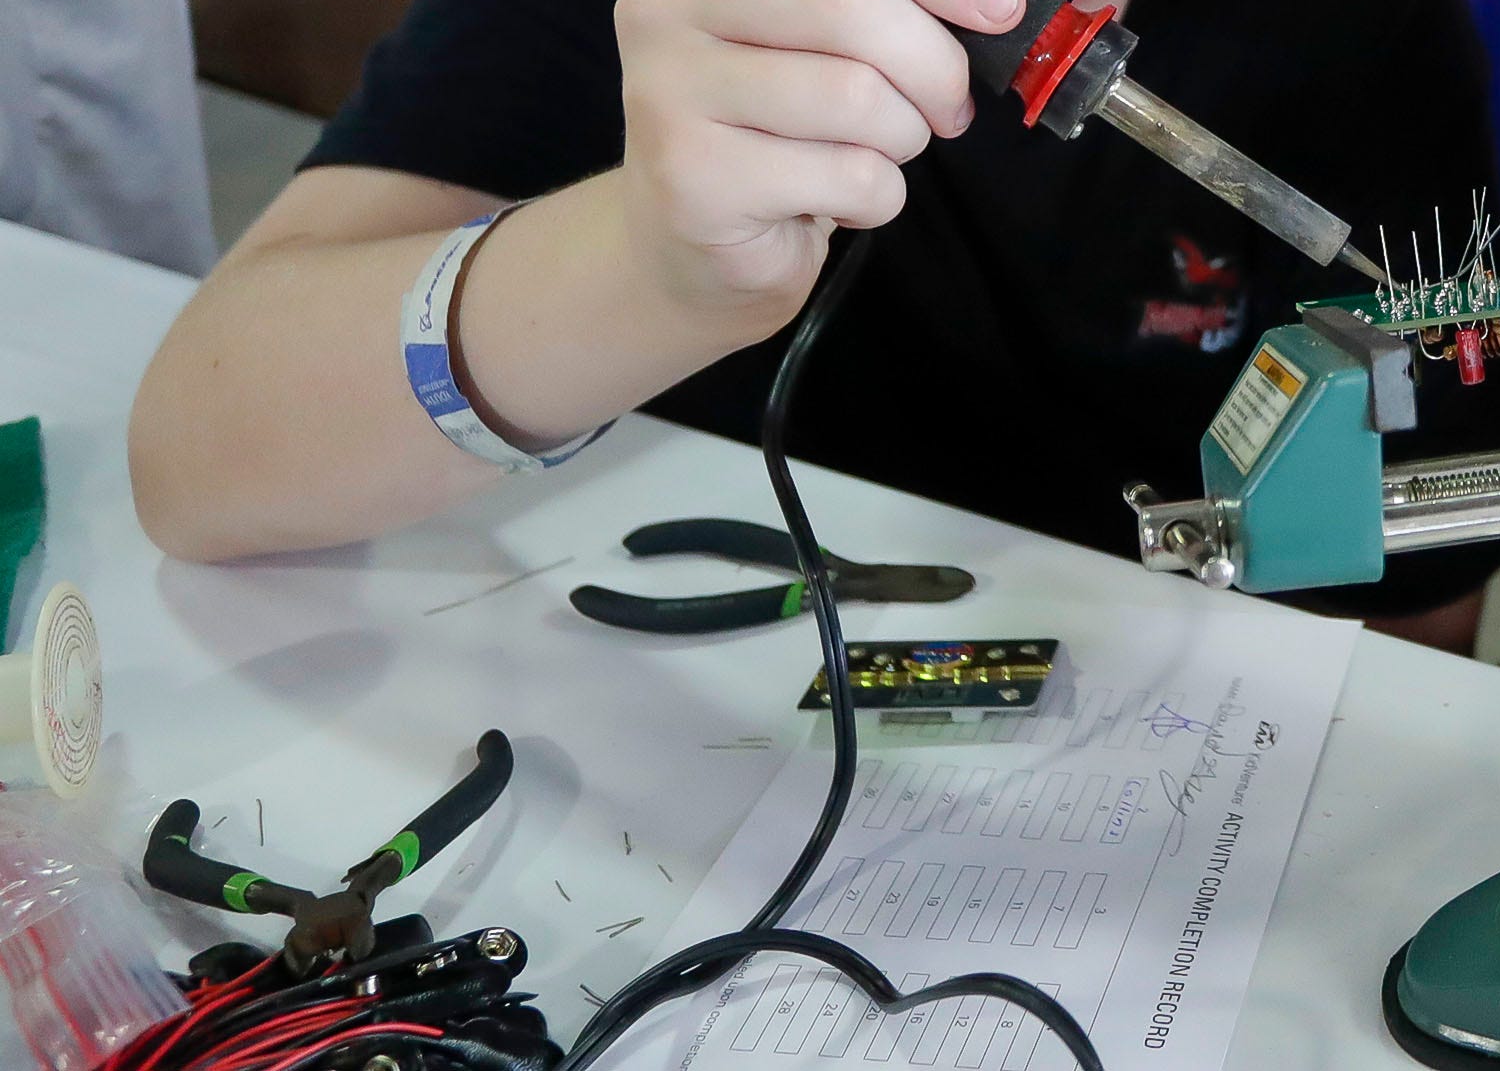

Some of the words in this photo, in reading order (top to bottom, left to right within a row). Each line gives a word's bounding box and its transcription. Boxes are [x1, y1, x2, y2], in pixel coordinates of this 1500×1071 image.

[1207, 812, 1244, 874] ACTIVITY
[886, 891, 900, 905] 23
[927, 895, 941, 907] 19
[968, 897, 982, 909] 15
[1010, 900, 1024, 910] 11
[1169, 878, 1221, 976] COMPLETION
[716, 981, 738, 1008] upon
[779, 1000, 795, 1015] 28
[822, 1003, 839, 1017] 24
[865, 1006, 882, 1021] 20
[910, 1008, 925, 1024] 16
[954, 1015, 970, 1028] 12
[1144, 981, 1185, 1049] RECORD
[1001, 1020, 1013, 1028] 8
